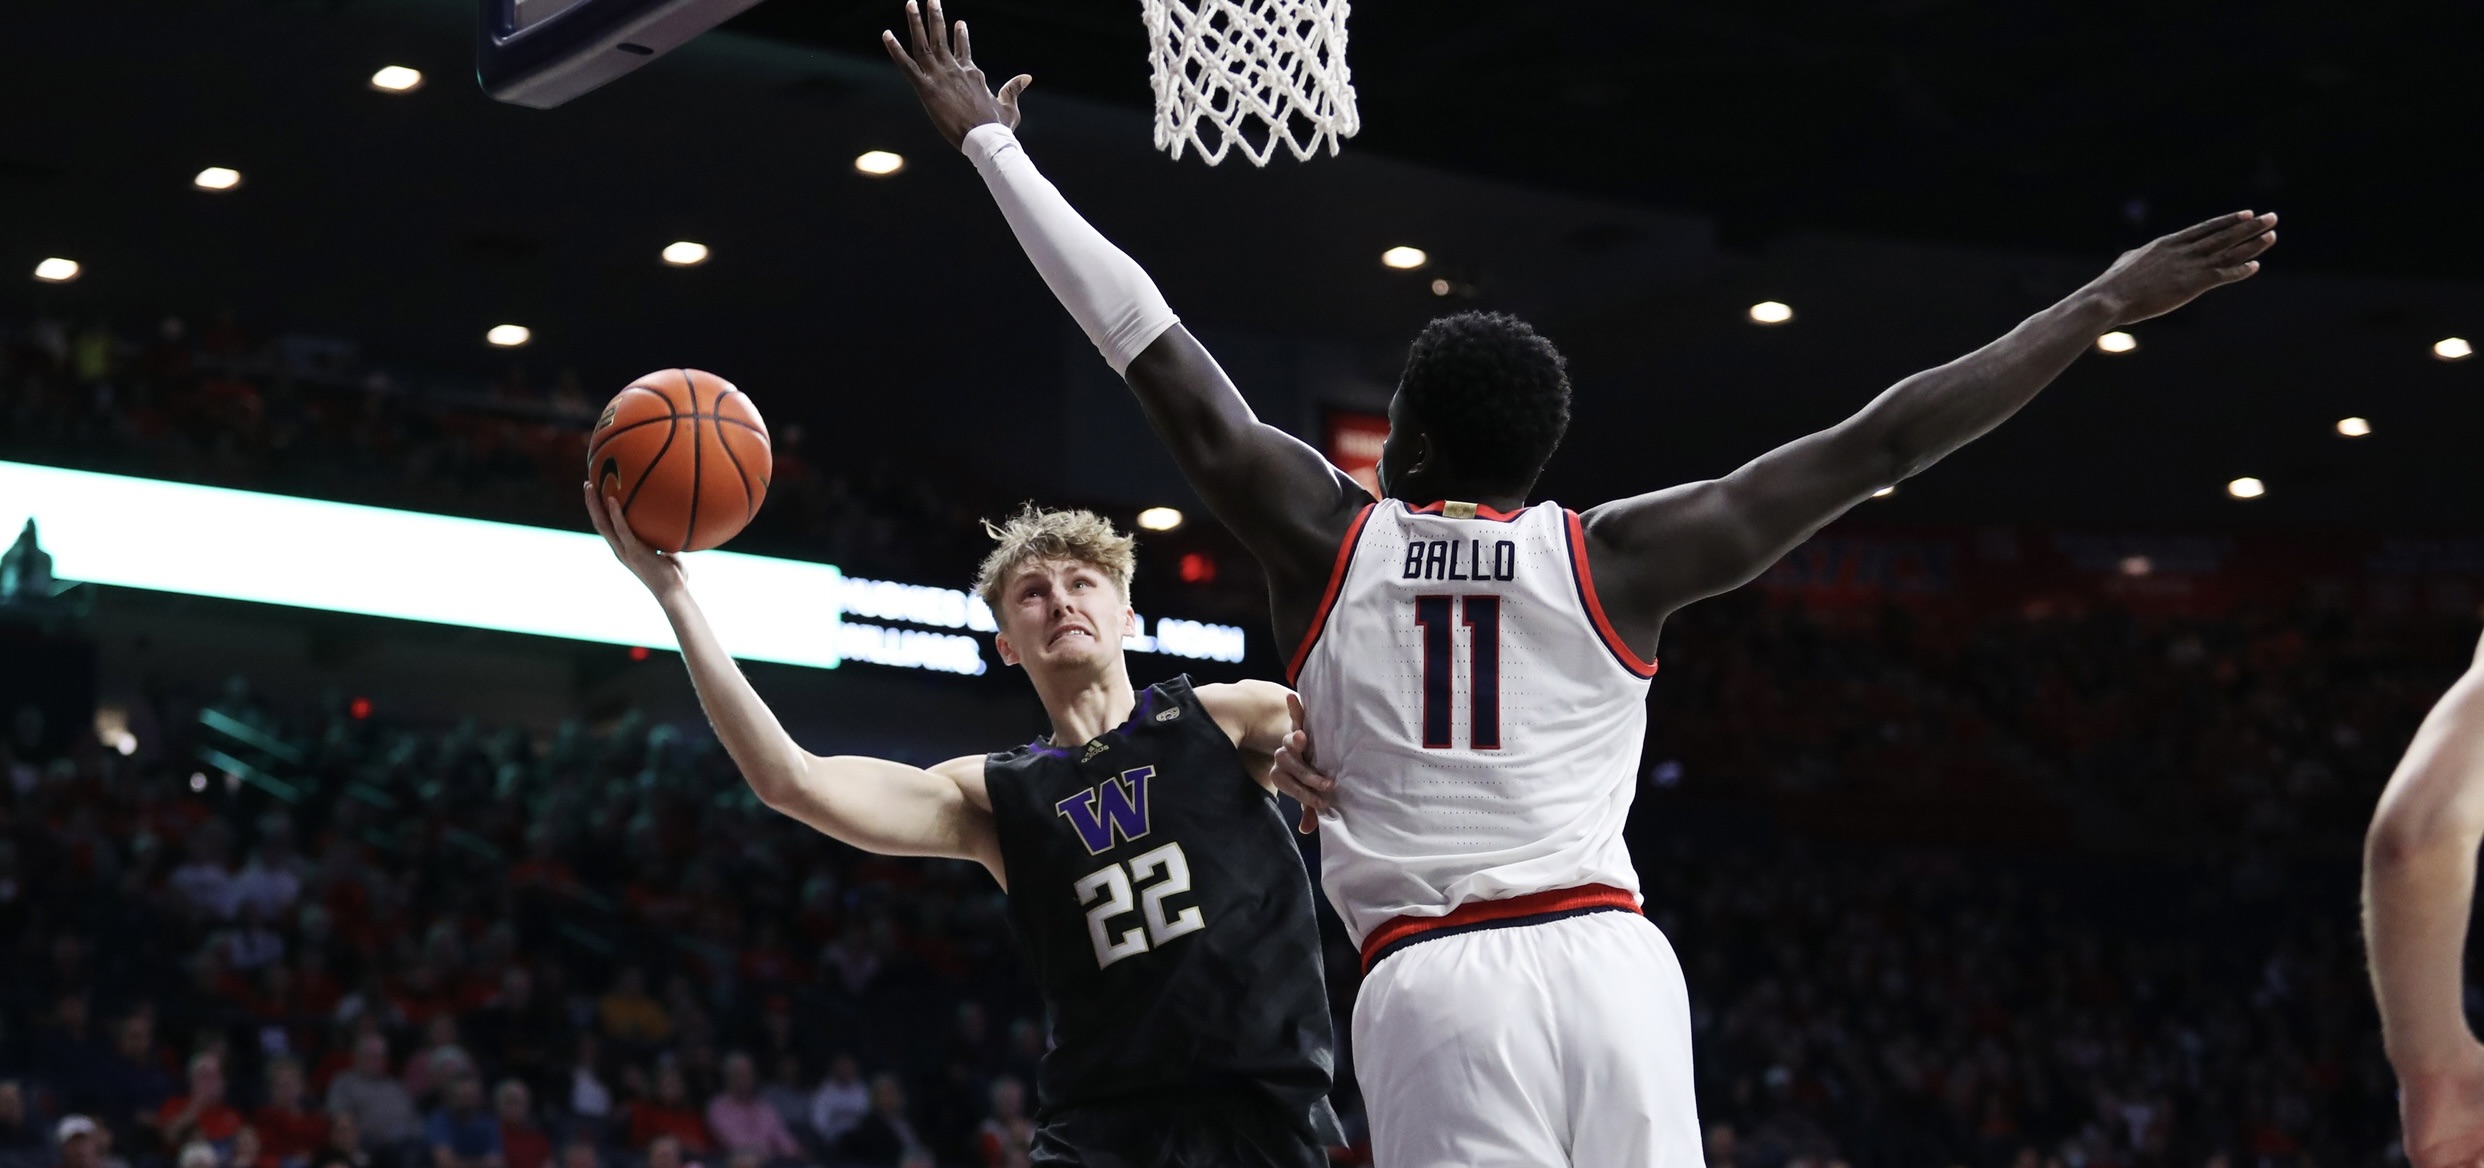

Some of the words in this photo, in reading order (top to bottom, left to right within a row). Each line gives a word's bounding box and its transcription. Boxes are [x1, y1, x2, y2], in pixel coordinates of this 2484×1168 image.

[1403, 540, 1516, 582] BALLO
[1414, 594, 1501, 750] 11
[1080, 744, 1110, 764] adidas
[1055, 764, 1157, 856] W
[1073, 841, 1206, 971] 22
